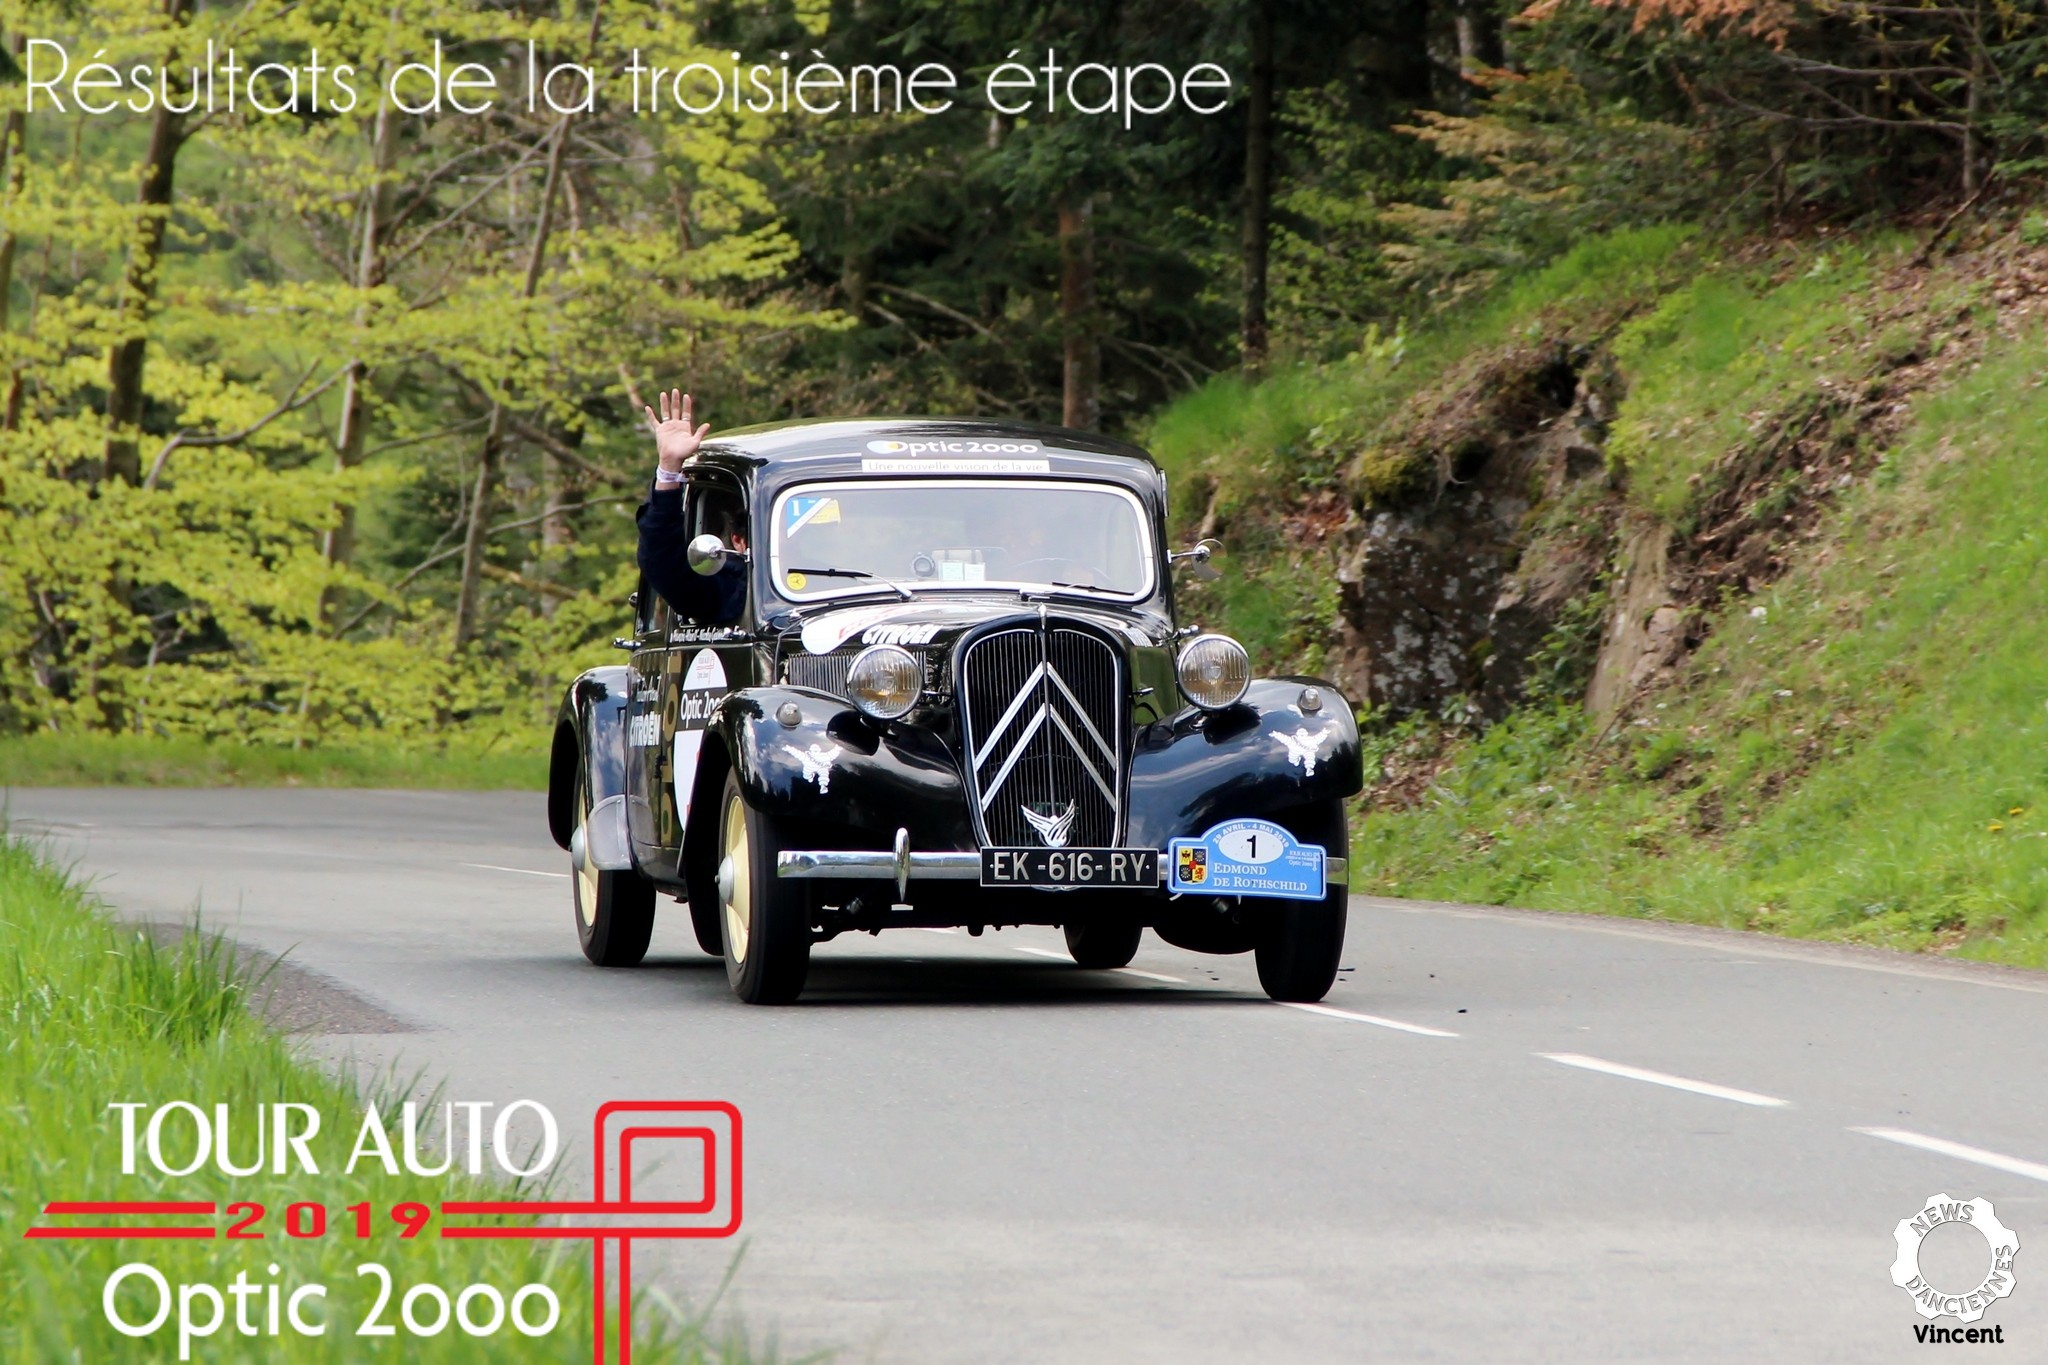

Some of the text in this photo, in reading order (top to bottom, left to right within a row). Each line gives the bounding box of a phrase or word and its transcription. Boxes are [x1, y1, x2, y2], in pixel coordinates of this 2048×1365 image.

[888, 440, 964, 457] Optic
[869, 461, 1043, 472] Une nouvelle vision de la vie
[680, 692, 703, 729] Optic
[1212, 834, 1222, 845] 29
[1222, 823, 1246, 835] AVRIL
[1259, 824, 1274, 834] MAI
[1274, 830, 1290, 848] 2019
[1246, 834, 1257, 859] 1
